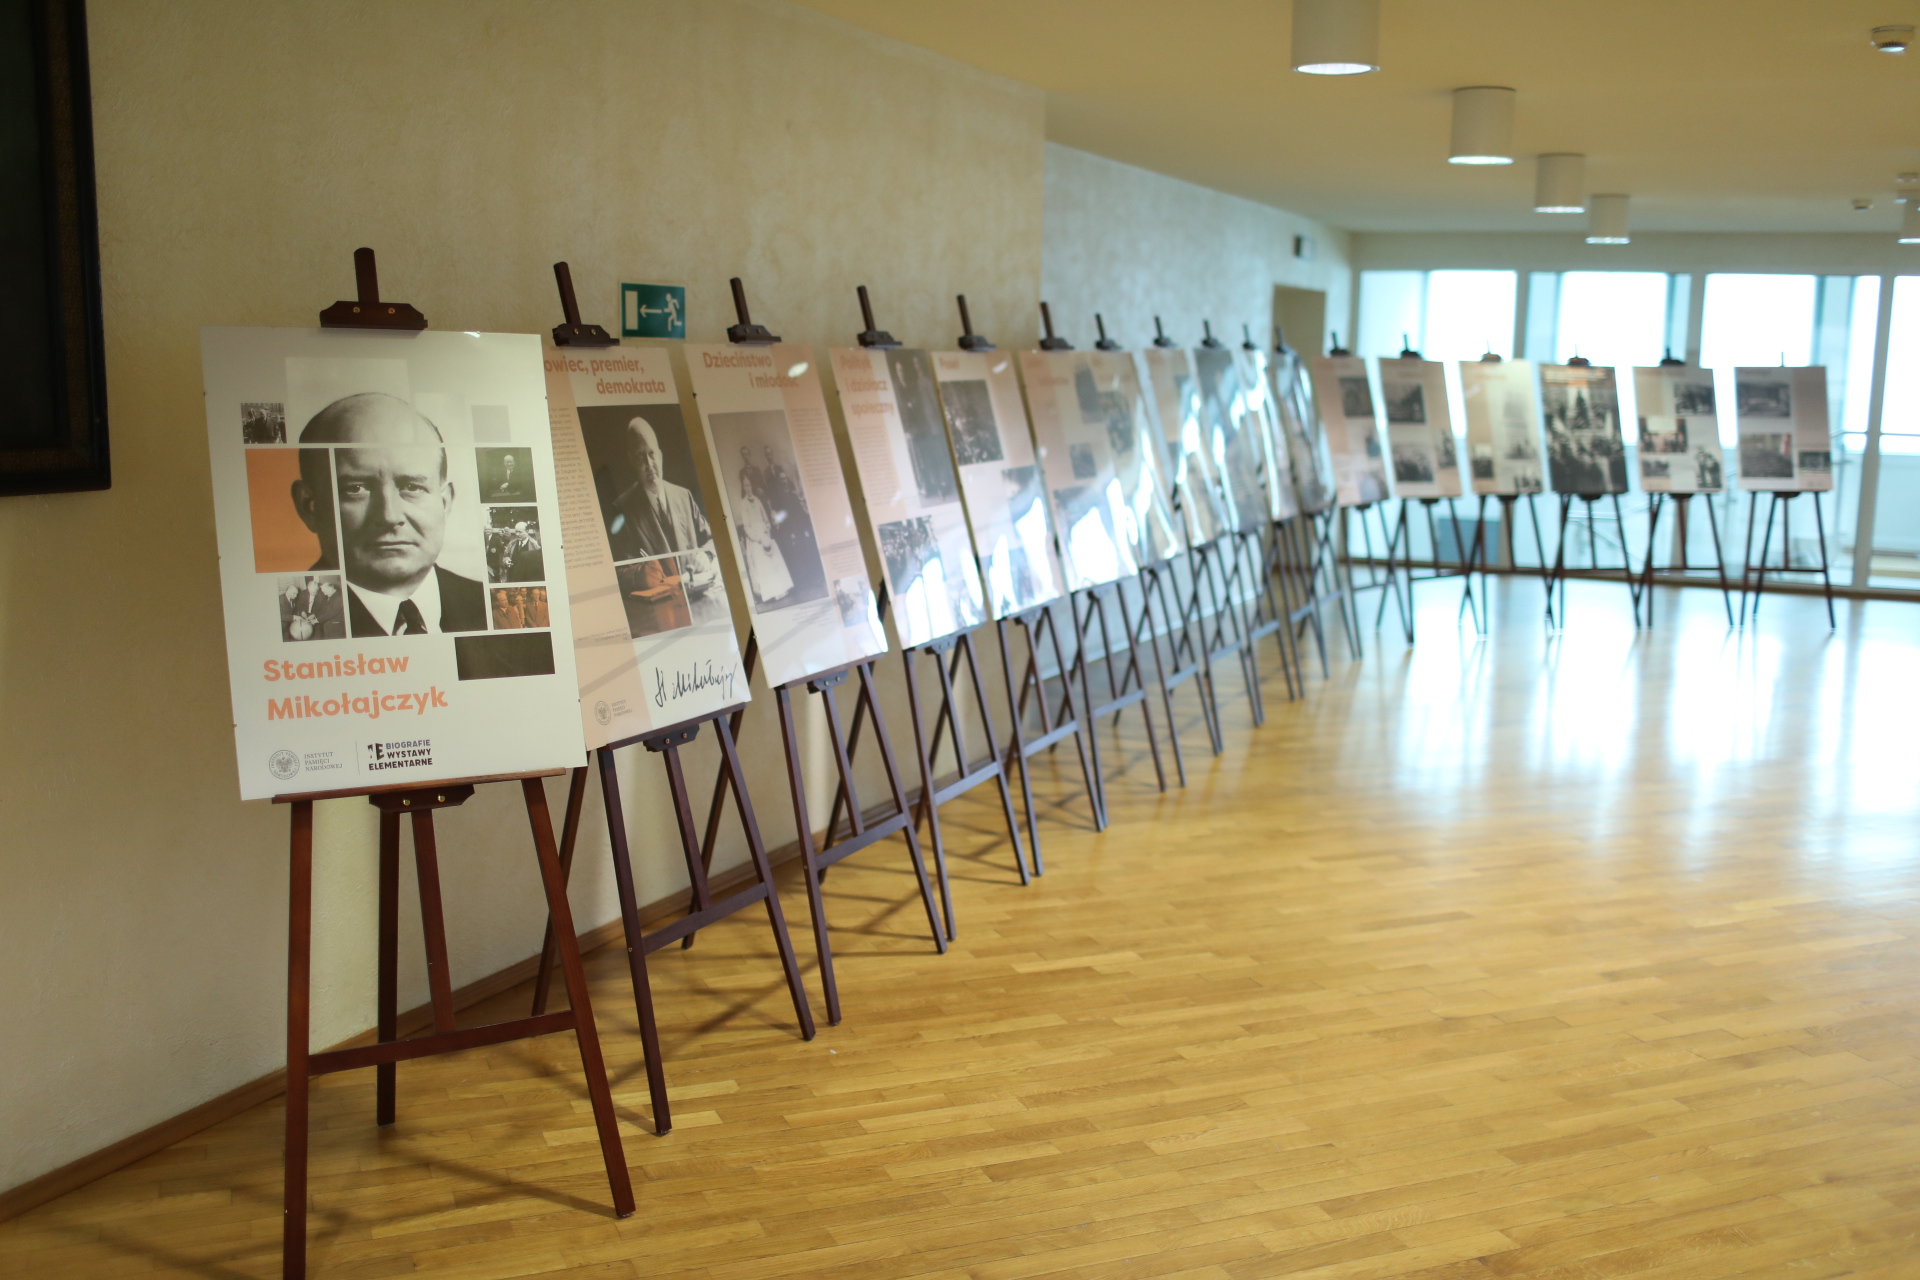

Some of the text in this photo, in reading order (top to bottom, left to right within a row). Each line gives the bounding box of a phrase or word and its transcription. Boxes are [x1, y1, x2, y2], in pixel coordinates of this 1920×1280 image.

[590, 356, 644, 376] premier,
[702, 352, 772, 369] Dzieciństwo
[596, 378, 666, 395] demokrata
[748, 372, 755, 389] i
[263, 653, 410, 682] Stanisław
[267, 686, 449, 721] Mikołajczyk
[385, 739, 431, 750] BIOGRAFIE
[304, 758, 330, 766] PAMIĘCI
[386, 748, 432, 759] WYSTAWY
[305, 763, 343, 772] NARODOWEJ
[368, 757, 434, 771] ELEMENTARNE
